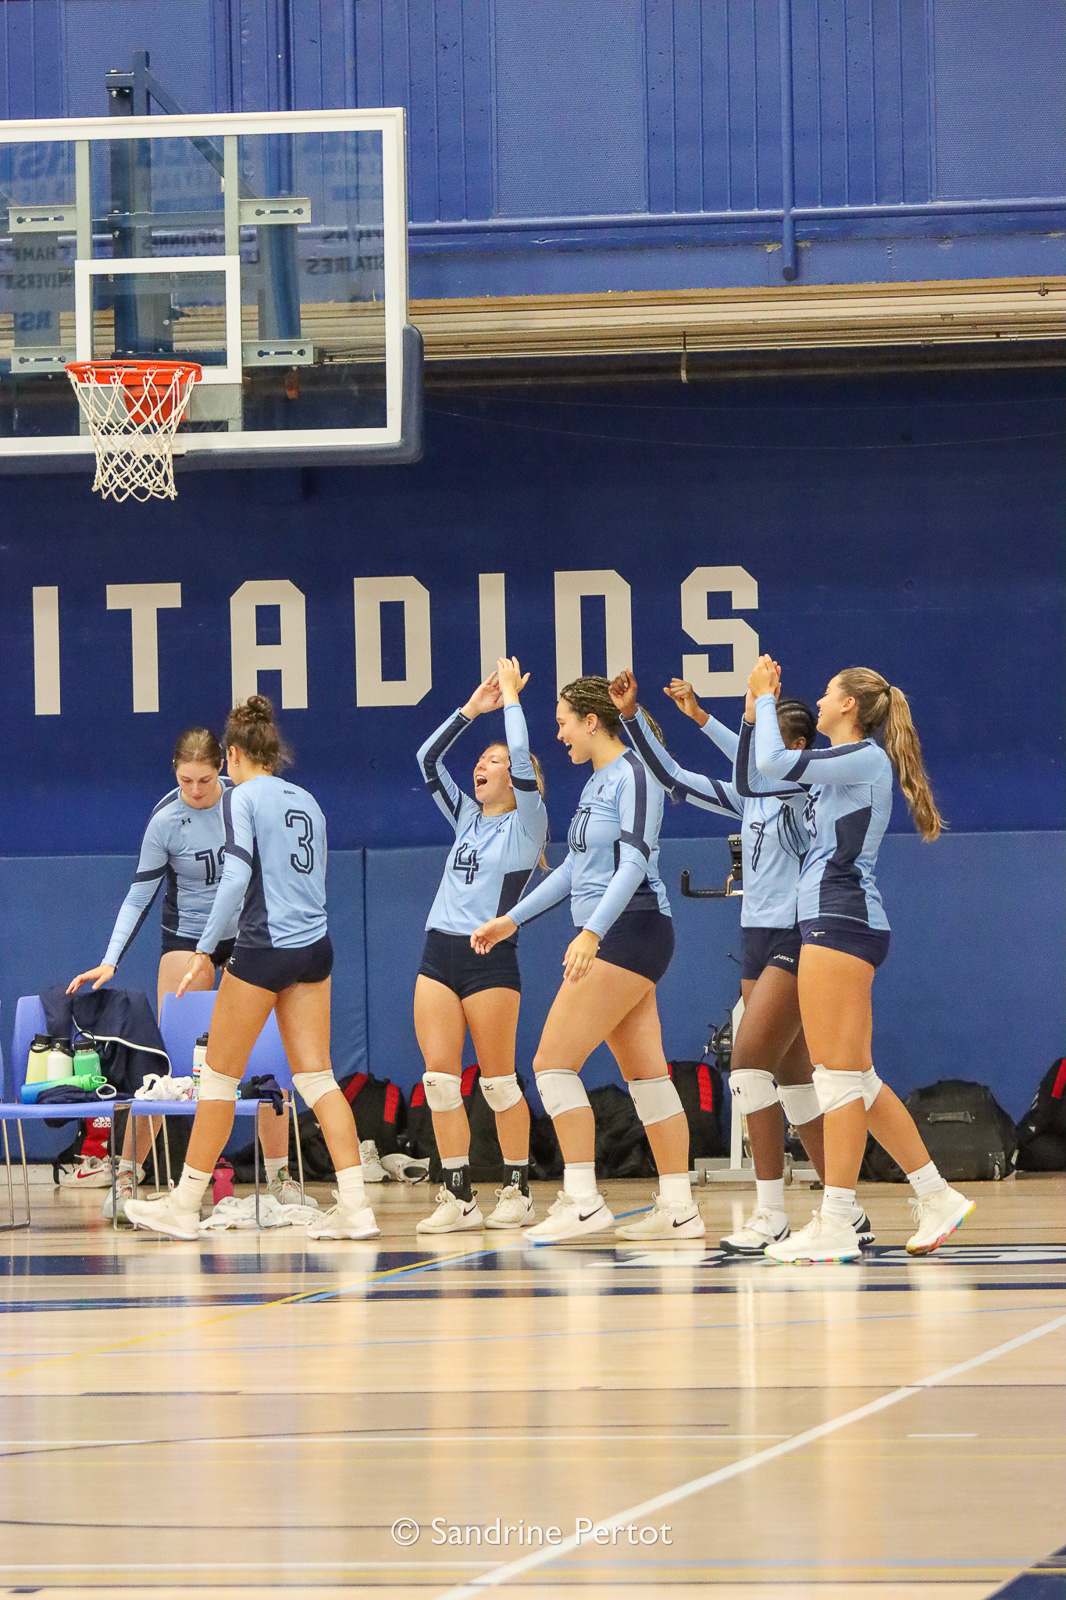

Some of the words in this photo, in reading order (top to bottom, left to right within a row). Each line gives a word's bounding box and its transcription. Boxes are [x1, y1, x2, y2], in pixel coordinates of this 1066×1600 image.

[285, 809, 314, 875] 3
[453, 843, 479, 884] 4
[750, 821, 765, 872] 7
